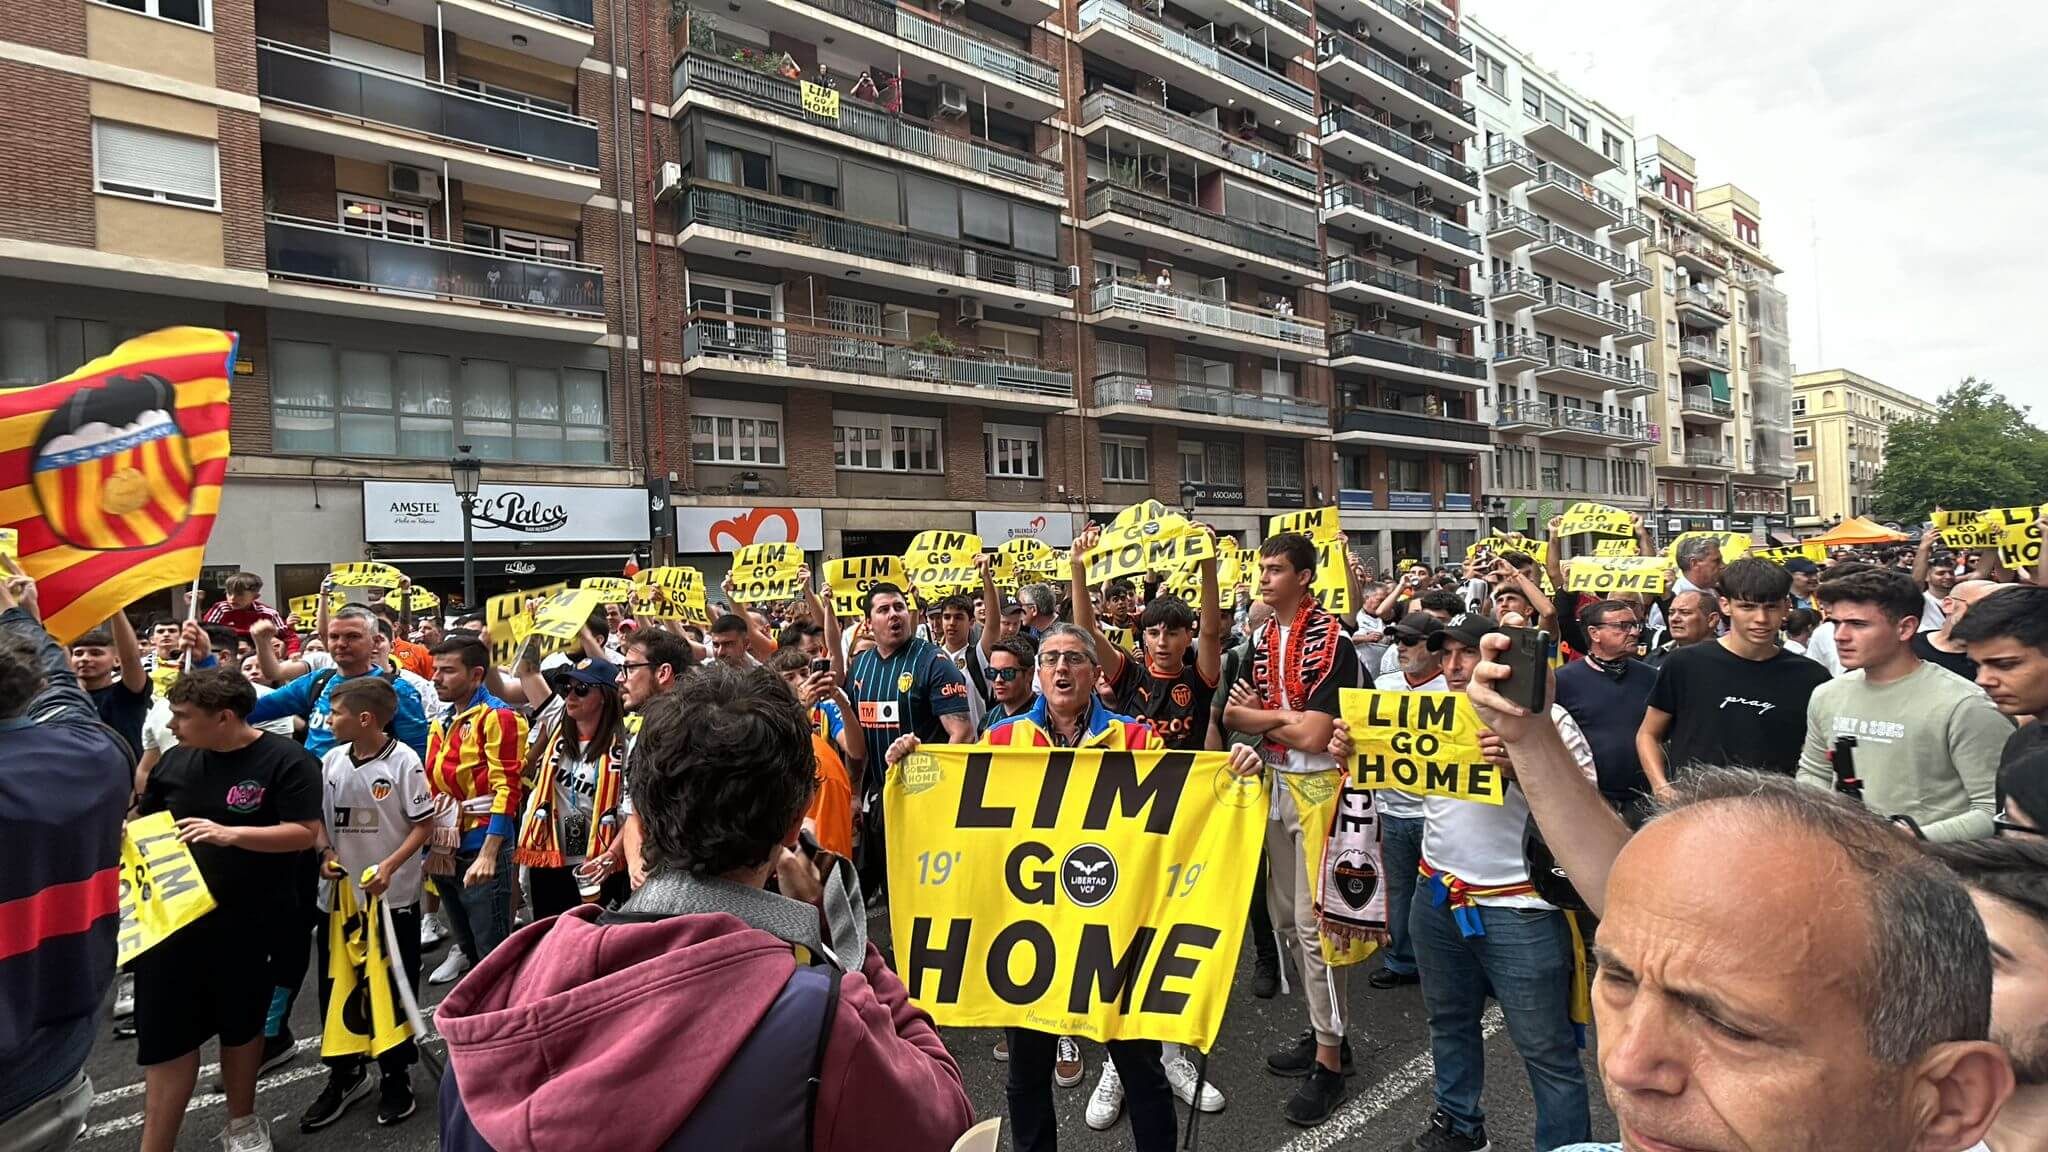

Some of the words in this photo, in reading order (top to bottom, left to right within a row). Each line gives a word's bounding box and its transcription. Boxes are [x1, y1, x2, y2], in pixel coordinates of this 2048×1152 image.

[809, 84, 831, 98] LIM
[804, 99, 837, 116] HOME
[814, 96, 827, 105] GO
[390, 502, 440, 513] AMSTEL
[473, 498, 494, 519] El
[496, 491, 567, 525] Palco
[1574, 505, 1616, 514] LIM
[2002, 507, 2041, 525] LI
[1107, 502, 1166, 534] LIM
[1280, 510, 1322, 532] LIM
[1946, 512, 1978, 526] LIM
[1124, 521, 1160, 540] GO
[1562, 522, 1630, 534] HOME
[917, 533, 965, 550] LIM
[1007, 540, 1041, 553] LIM
[1604, 540, 1630, 550] LIM
[1946, 533, 1997, 546] HOME
[742, 544, 786, 566] LIM
[928, 552, 950, 565] GO
[1017, 553, 1035, 562] GO
[1091, 534, 1204, 578] HOME
[2002, 541, 2042, 564] HO
[753, 565, 776, 578] GO
[843, 557, 890, 579] LIM
[907, 567, 975, 582] HOME
[589, 577, 619, 589] LIM
[664, 569, 693, 591] LIM
[1572, 573, 1661, 589] HOME
[672, 590, 687, 603] GO
[734, 579, 799, 599] HOME
[659, 601, 705, 621] HOME
[861, 707, 875, 718] TM
[1368, 694, 1456, 732] LIM
[1720, 696, 1776, 715] pray
[1391, 731, 1440, 757] GO
[910, 756, 929, 765] LIM
[908, 773, 938, 783] HOME
[1357, 754, 1494, 796] HOME
[955, 751, 1196, 835] LIM
[135, 831, 199, 902] LIM
[1005, 841, 1118, 907] GO
[1071, 876, 1108, 886] LIBERTAD
[1080, 885, 1096, 894] VCF
[909, 917, 1222, 1016] HOME
